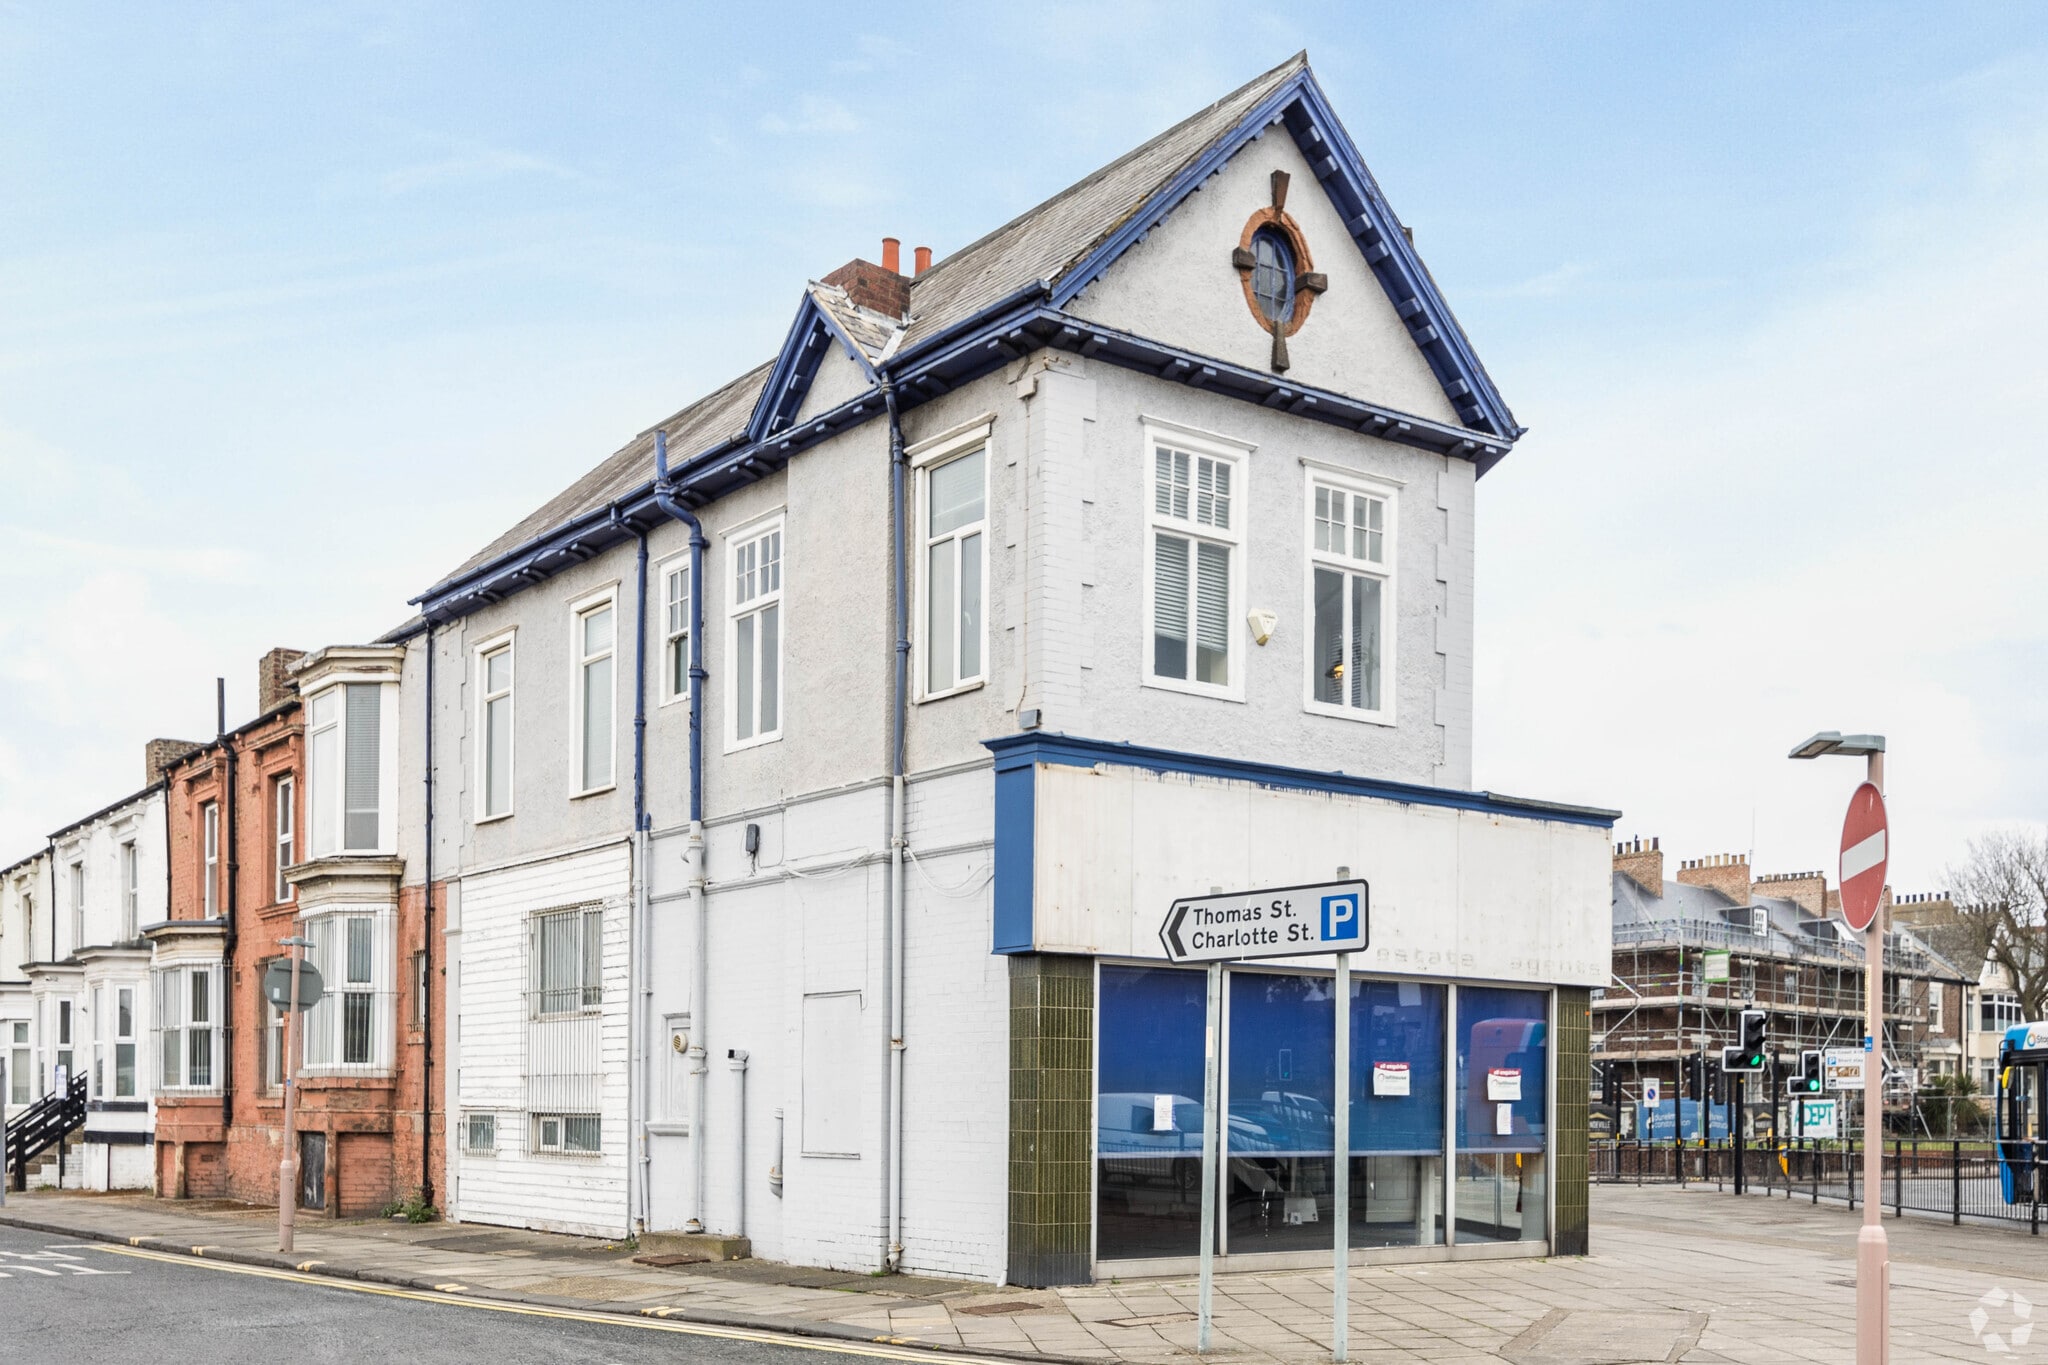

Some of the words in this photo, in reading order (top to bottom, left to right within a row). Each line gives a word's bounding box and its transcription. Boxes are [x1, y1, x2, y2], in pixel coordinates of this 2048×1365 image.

[1193, 904, 1262, 926] Thomas
[1270, 900, 1297, 918] St.
[1329, 898, 1353, 938] P
[1192, 926, 1278, 950] Charlotte
[1287, 922, 1315, 941] St.
